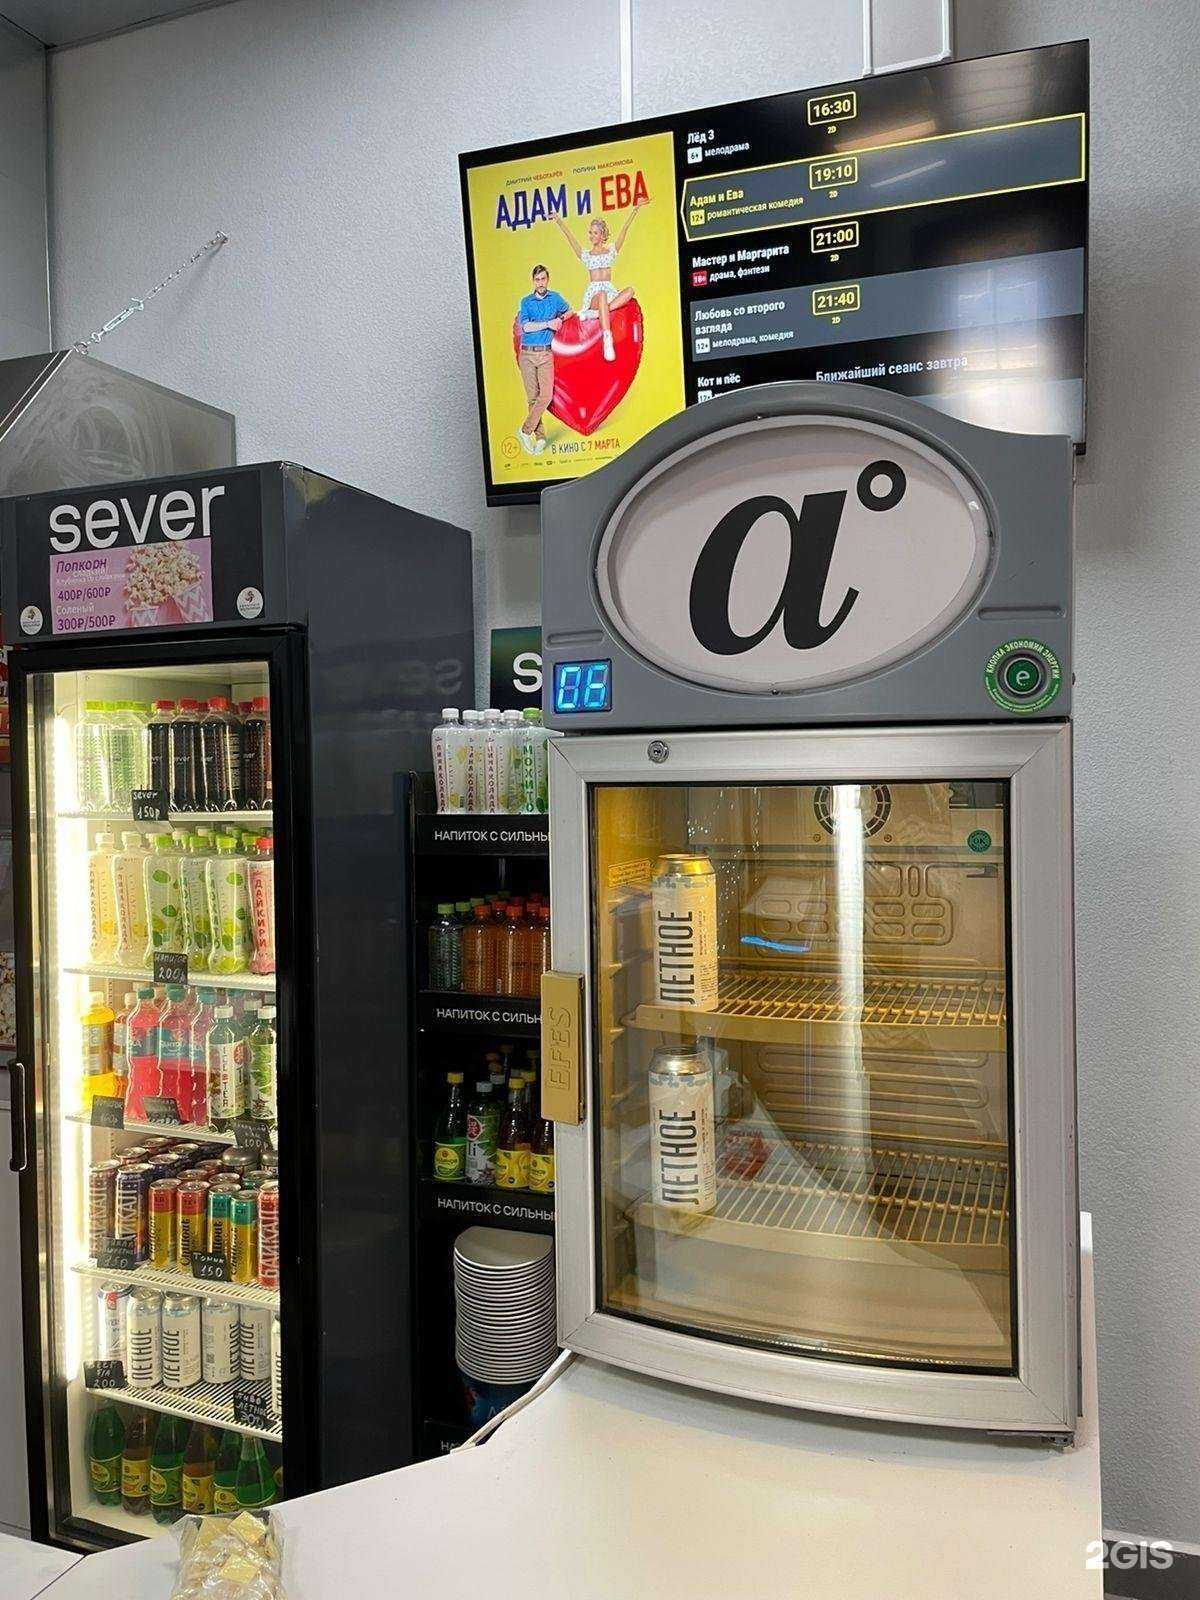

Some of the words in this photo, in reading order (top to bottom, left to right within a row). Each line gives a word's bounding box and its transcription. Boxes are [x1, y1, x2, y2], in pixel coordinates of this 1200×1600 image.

[813, 99, 851, 118] 16:30
[687, 131, 706, 145] Лёд
[707, 129, 715, 141] 3
[827, 125, 837, 134] 2D
[704, 141, 750, 157] мелодрама
[814, 164, 853, 182] 19:10
[495, 183, 568, 231] АДАМ
[600, 170, 650, 212] ЕВА
[689, 194, 717, 207] Адам
[718, 193, 725, 202] и
[726, 188, 744, 201] Ева
[828, 190, 838, 199] 2D
[706, 202, 767, 220] романтическая
[768, 196, 804, 210] комедия
[815, 228, 854, 246] 21:00
[692, 254, 727, 269] Мастер
[729, 254, 736, 263] и
[737, 245, 790, 262] Маргарита
[829, 254, 840, 262] 2D
[709, 269, 737, 283] драма,
[737, 264, 770, 278] фэнтези
[817, 291, 855, 309] 21:40
[694, 308, 732, 323] Любовь
[733, 307, 745, 316] со
[747, 301, 786, 315] второго
[831, 316, 841, 325] 2D
[695, 321, 733, 336] взгляда
[712, 336, 758, 349] мелодрама,
[759, 330, 794, 343] комедия
[815, 363, 886, 382] Ближайший
[888, 362, 924, 375] сеанс
[926, 354, 968, 370] завтра
[697, 377, 714, 388] Кот
[716, 376, 723, 386] и
[723, 373, 741, 385] пёс
[551, 444, 557, 455] В
[558, 442, 579, 455] КИНО
[581, 441, 587, 452] С
[588, 440, 594, 451] 7
[595, 437, 622, 451] МАРТА
[49, 485, 226, 553] sever
[56, 558, 107, 574] Попкорн
[56, 602, 95, 615] Соленый
[985, 648, 1006, 674] КНОПКА
[1004, 640, 1044, 654] ЭКОНОМИИ
[1042, 649, 1060, 679] ЭНЕРГИИ
[133, 789, 159, 800] sever
[434, 829, 488, 842] НАПИТОК
[489, 830, 499, 842] С
[254, 879, 267, 948] ДАЙКИРИ
[657, 910, 696, 1005] ЛЕТНОЕ
[436, 1008, 490, 1022] НАПИТОК
[491, 1011, 500, 1022] С
[545, 1006, 572, 1091] EFES
[659, 1109, 700, 1205] ЛЕТНОЕ
[437, 1198, 492, 1215] НАПИТОК
[493, 1204, 502, 1215] С
[200, 1264, 223, 1278] 150
[130, 1328, 153, 1381] ЛЕТНОЕ
[93, 1378, 116, 1388] 200
